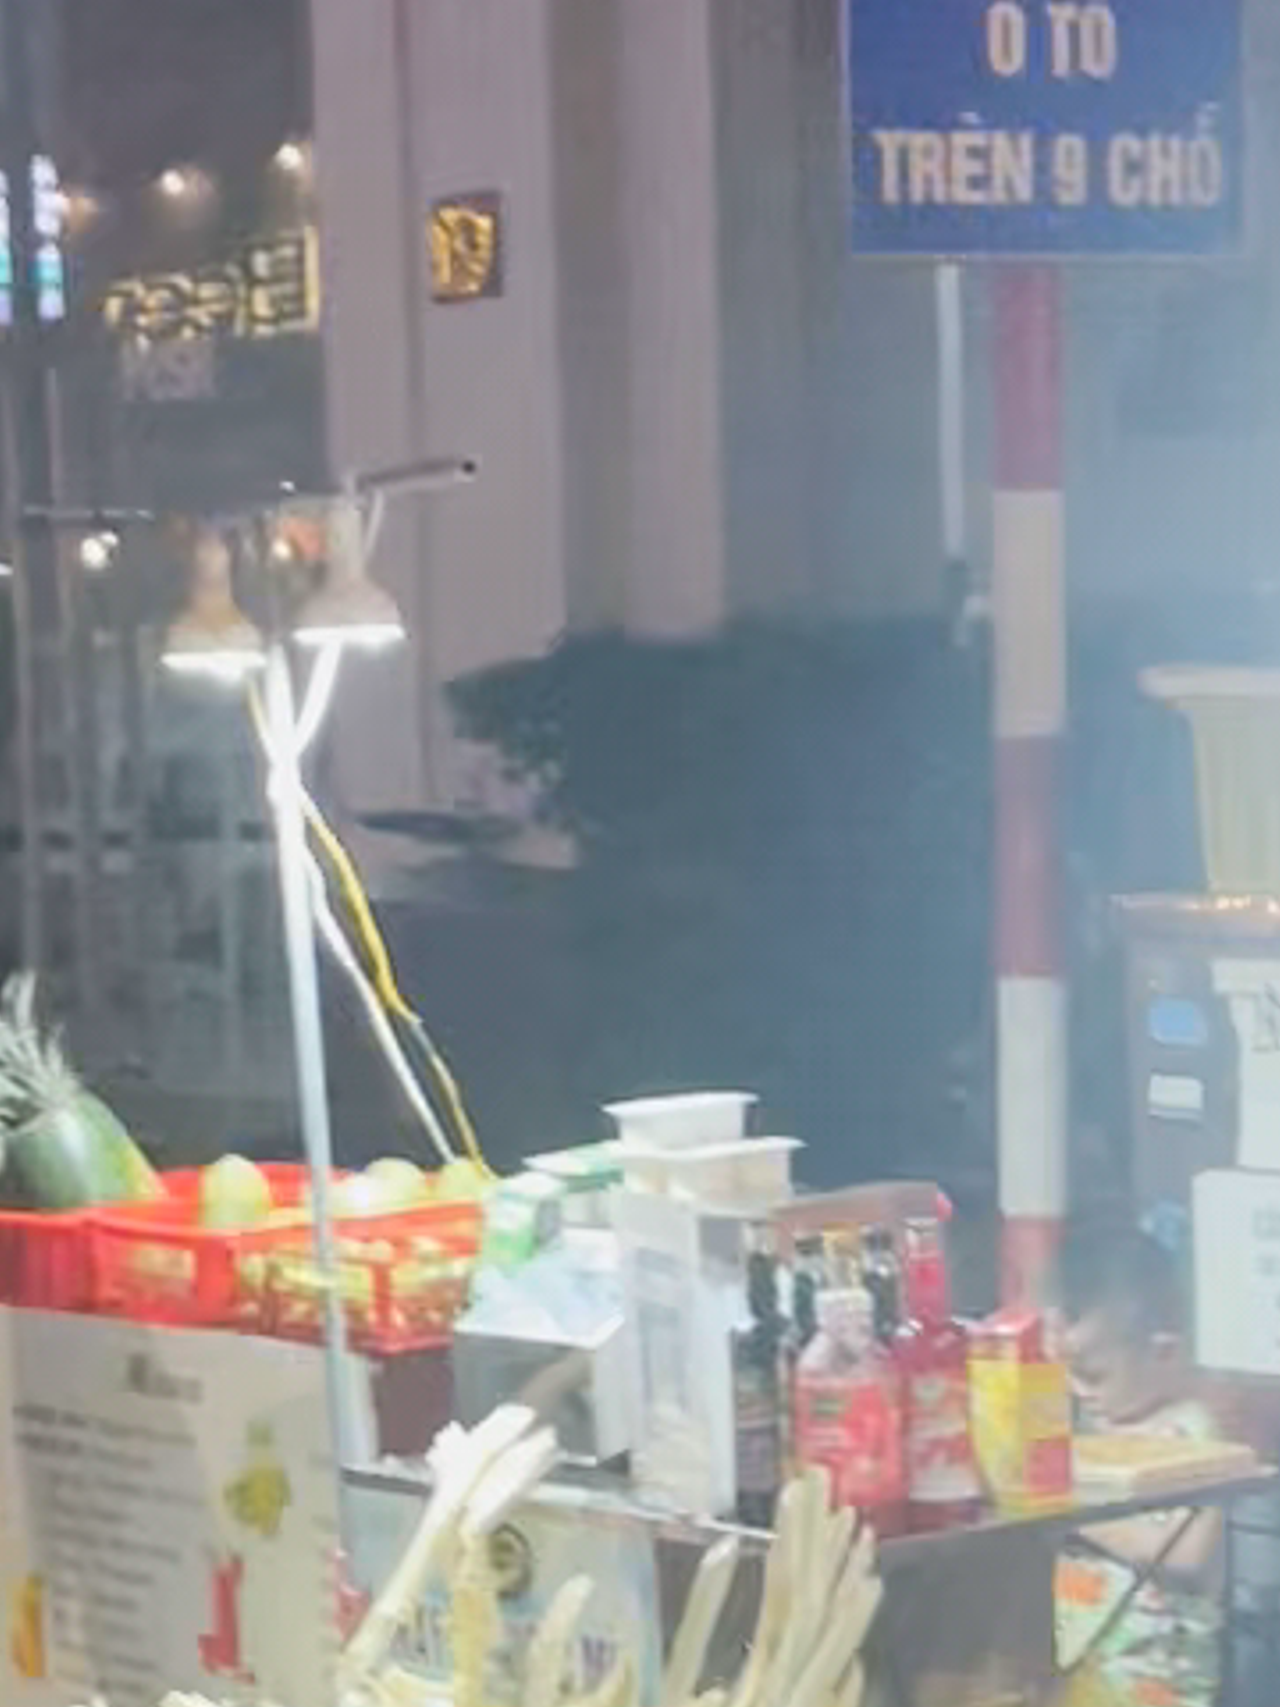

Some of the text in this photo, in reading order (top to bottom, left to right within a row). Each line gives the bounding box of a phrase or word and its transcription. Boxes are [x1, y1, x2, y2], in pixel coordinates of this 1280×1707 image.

[870, 101, 1224, 207] TRÊN 9 CHỖ
